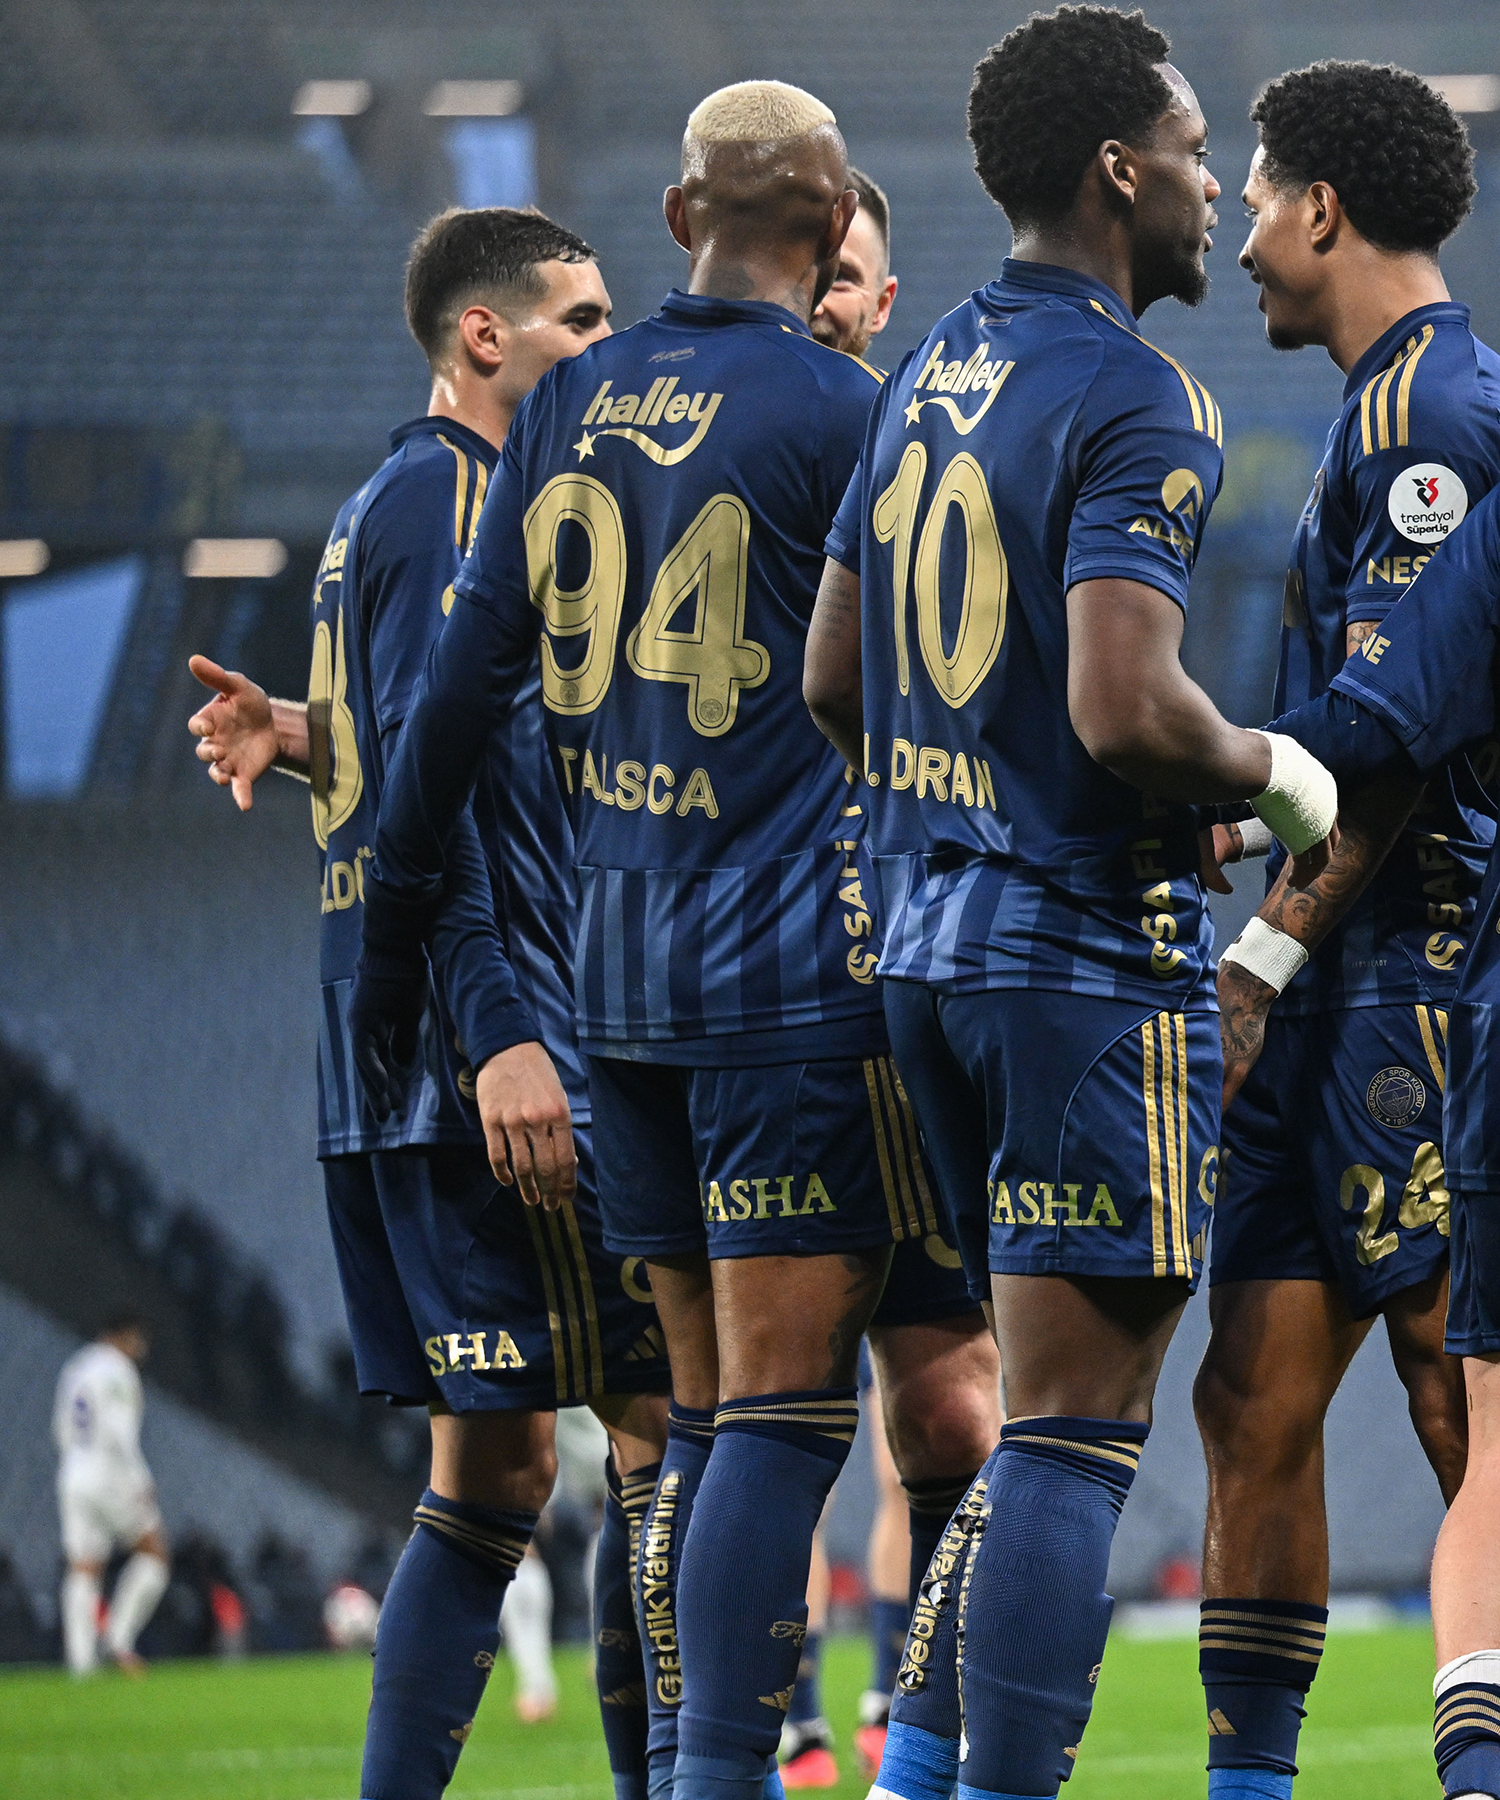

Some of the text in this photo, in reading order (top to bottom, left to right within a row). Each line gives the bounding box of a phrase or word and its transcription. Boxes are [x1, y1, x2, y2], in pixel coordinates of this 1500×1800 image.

[573, 376, 725, 467] halley
[905, 340, 1017, 436] halley
[1400, 509, 1455, 525] trendyol
[522, 472, 770, 737] 94
[872, 440, 1009, 709] 10
[558, 745, 720, 819] TALSCA
[890, 738, 997, 812] DRAN
[699, 1172, 838, 1222] ASHA
[1339, 1140, 1451, 1267] 24
